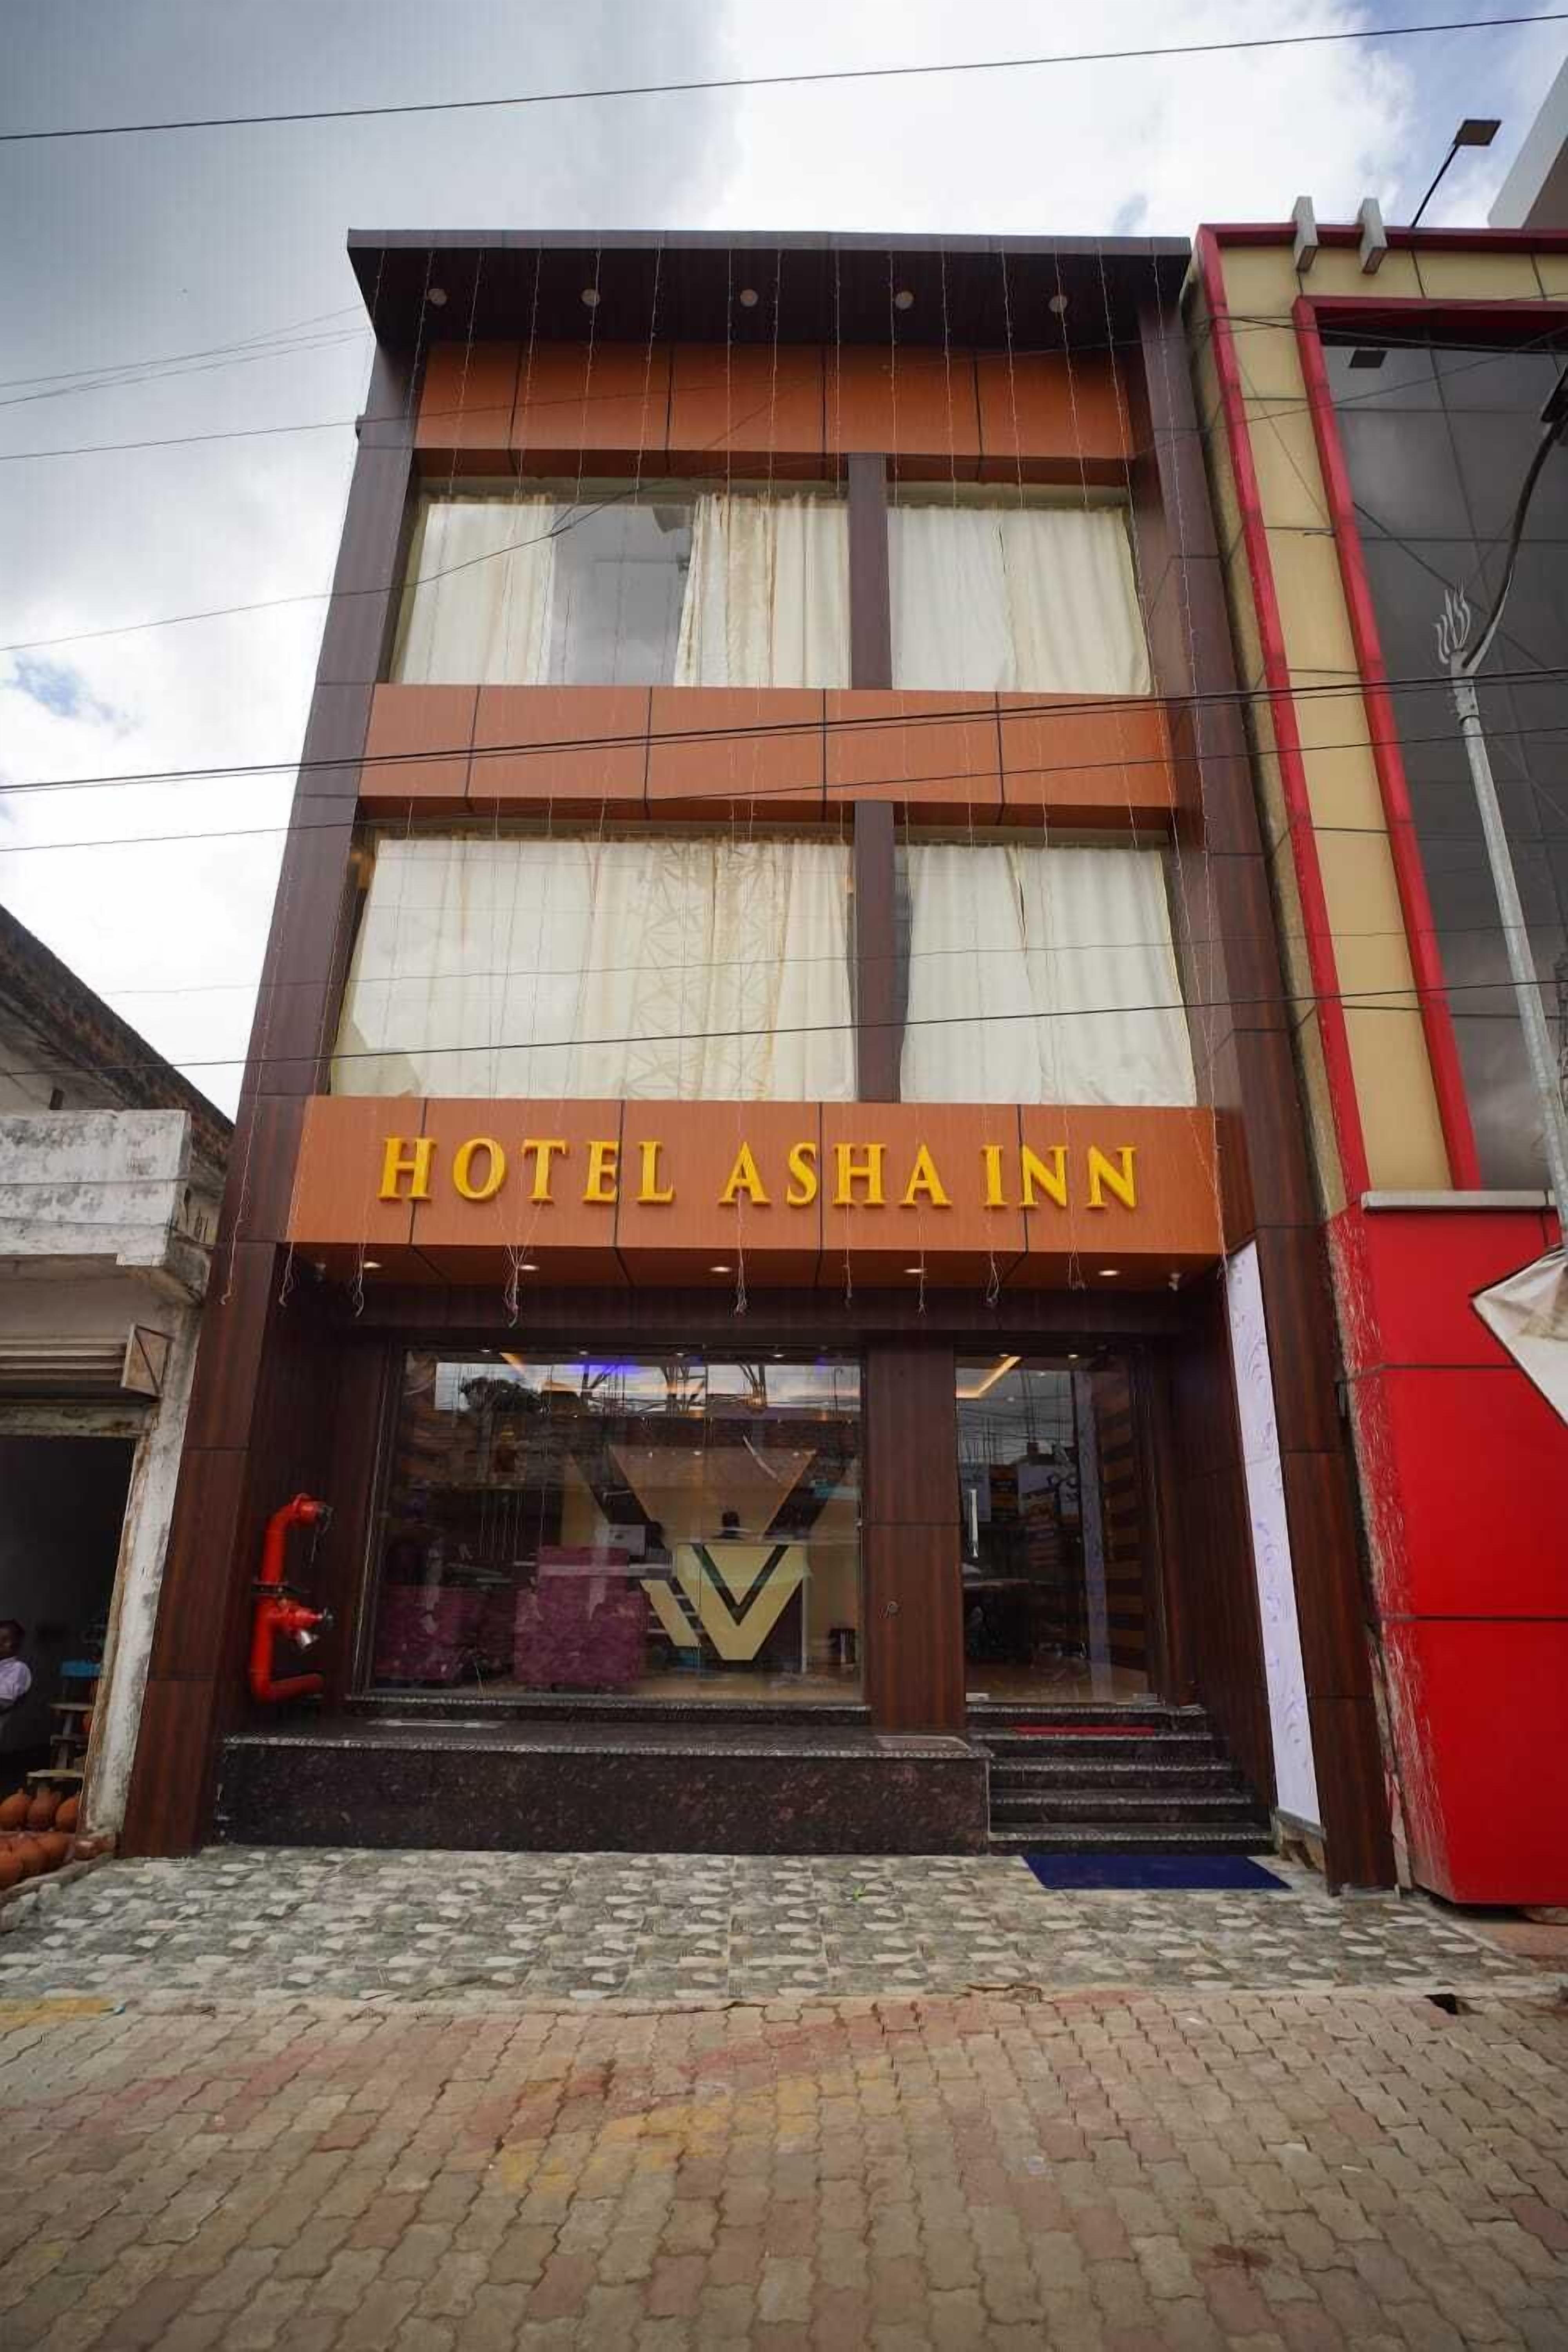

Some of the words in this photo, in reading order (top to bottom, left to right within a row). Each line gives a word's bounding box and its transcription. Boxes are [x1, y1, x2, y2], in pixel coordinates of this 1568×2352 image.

[377, 1136, 675, 1203] HOTEL
[721, 1141, 951, 1206] ASHA
[983, 1142, 1138, 1209] INN
